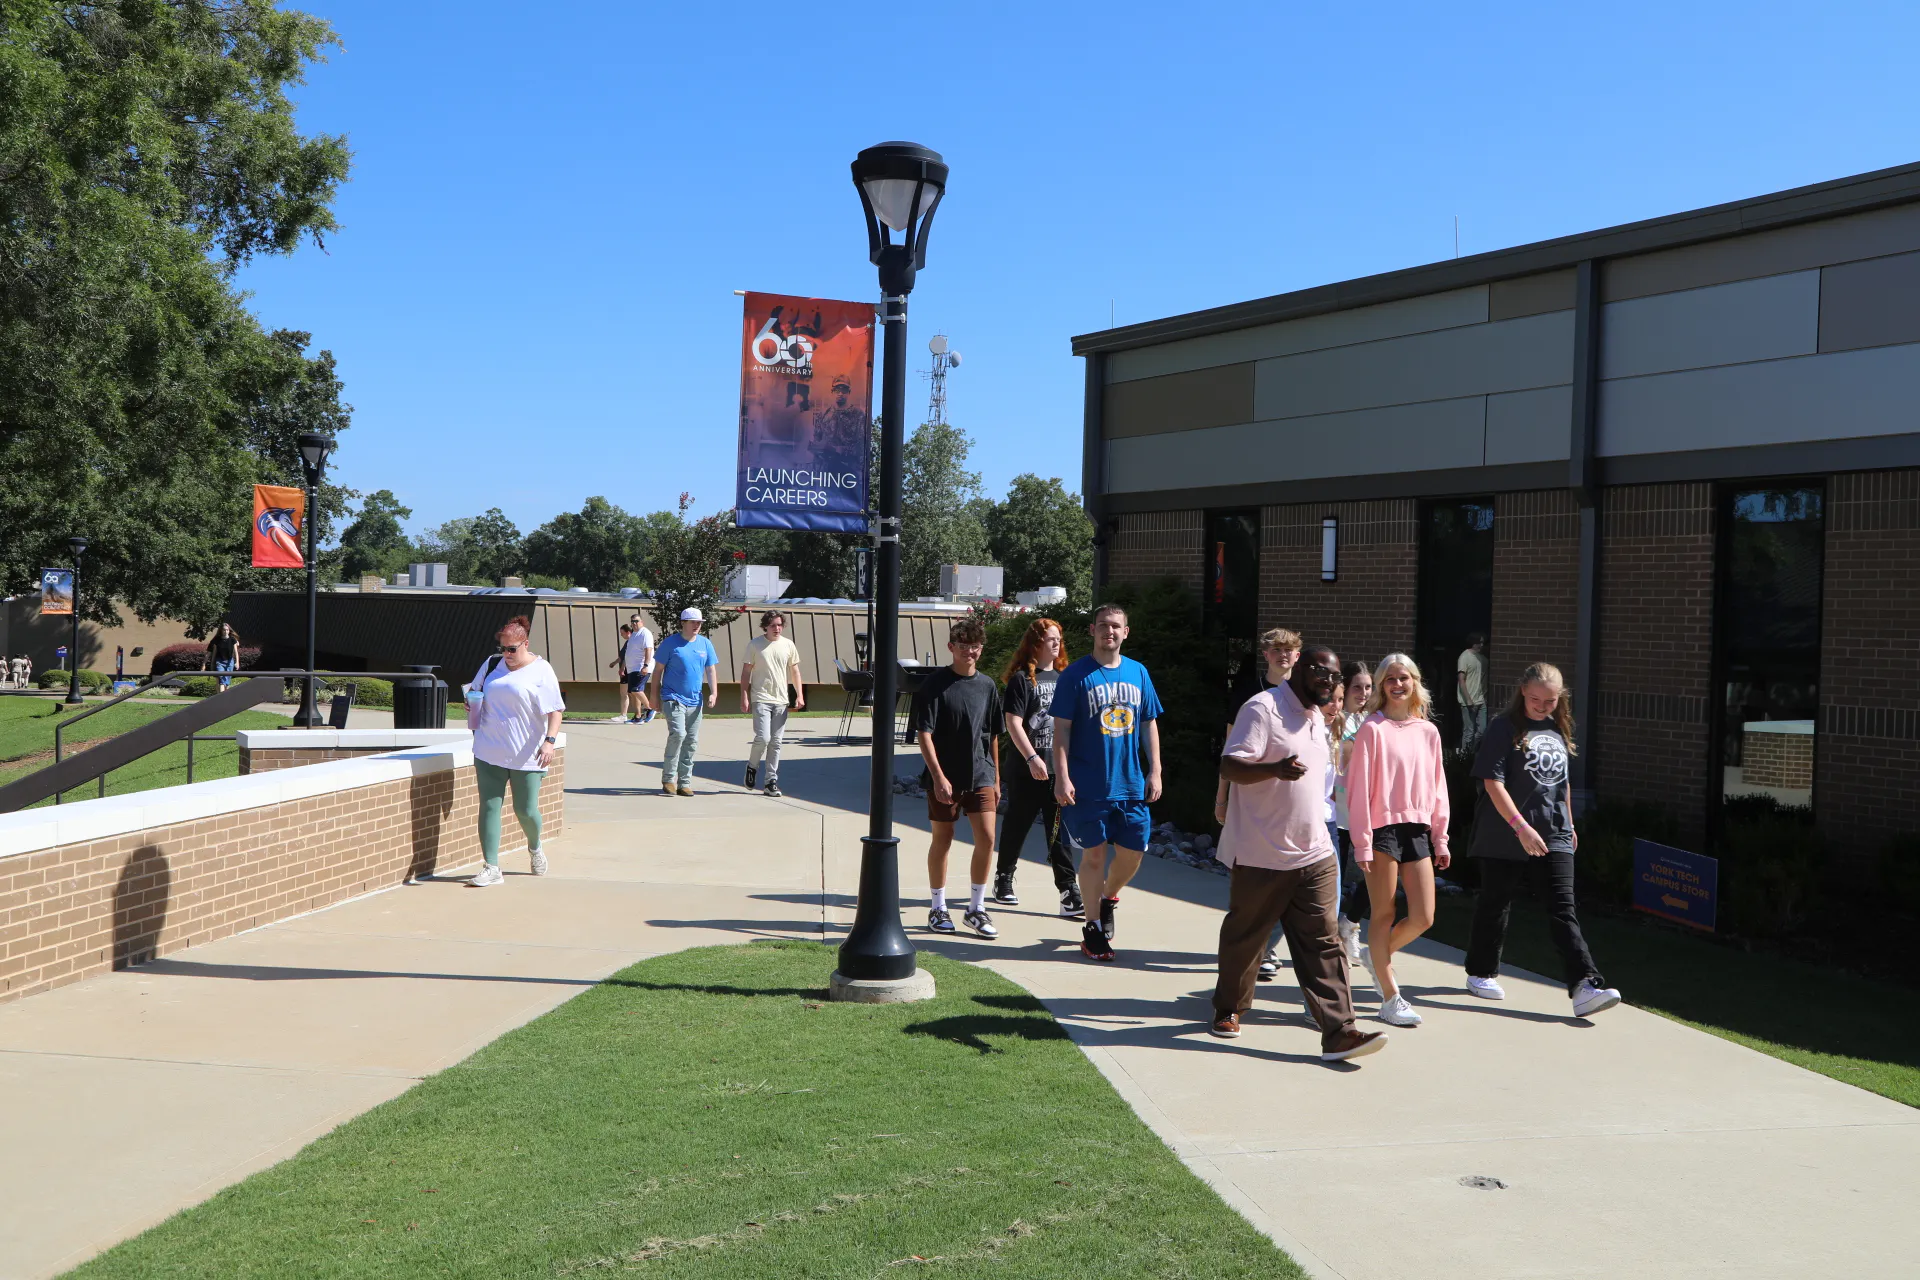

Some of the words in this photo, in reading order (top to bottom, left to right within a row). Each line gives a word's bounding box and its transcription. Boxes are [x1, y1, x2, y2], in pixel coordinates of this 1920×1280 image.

[753, 365, 813, 376] ANNIVERSARY
[747, 466, 857, 489] LAUNCHING
[745, 486, 828, 507] CAREERS
[1650, 863, 1674, 877] YORK
[1677, 871, 1699, 884] TECH
[1642, 873, 1680, 890] CAMPUS
[1683, 885, 1709, 899] STORE
